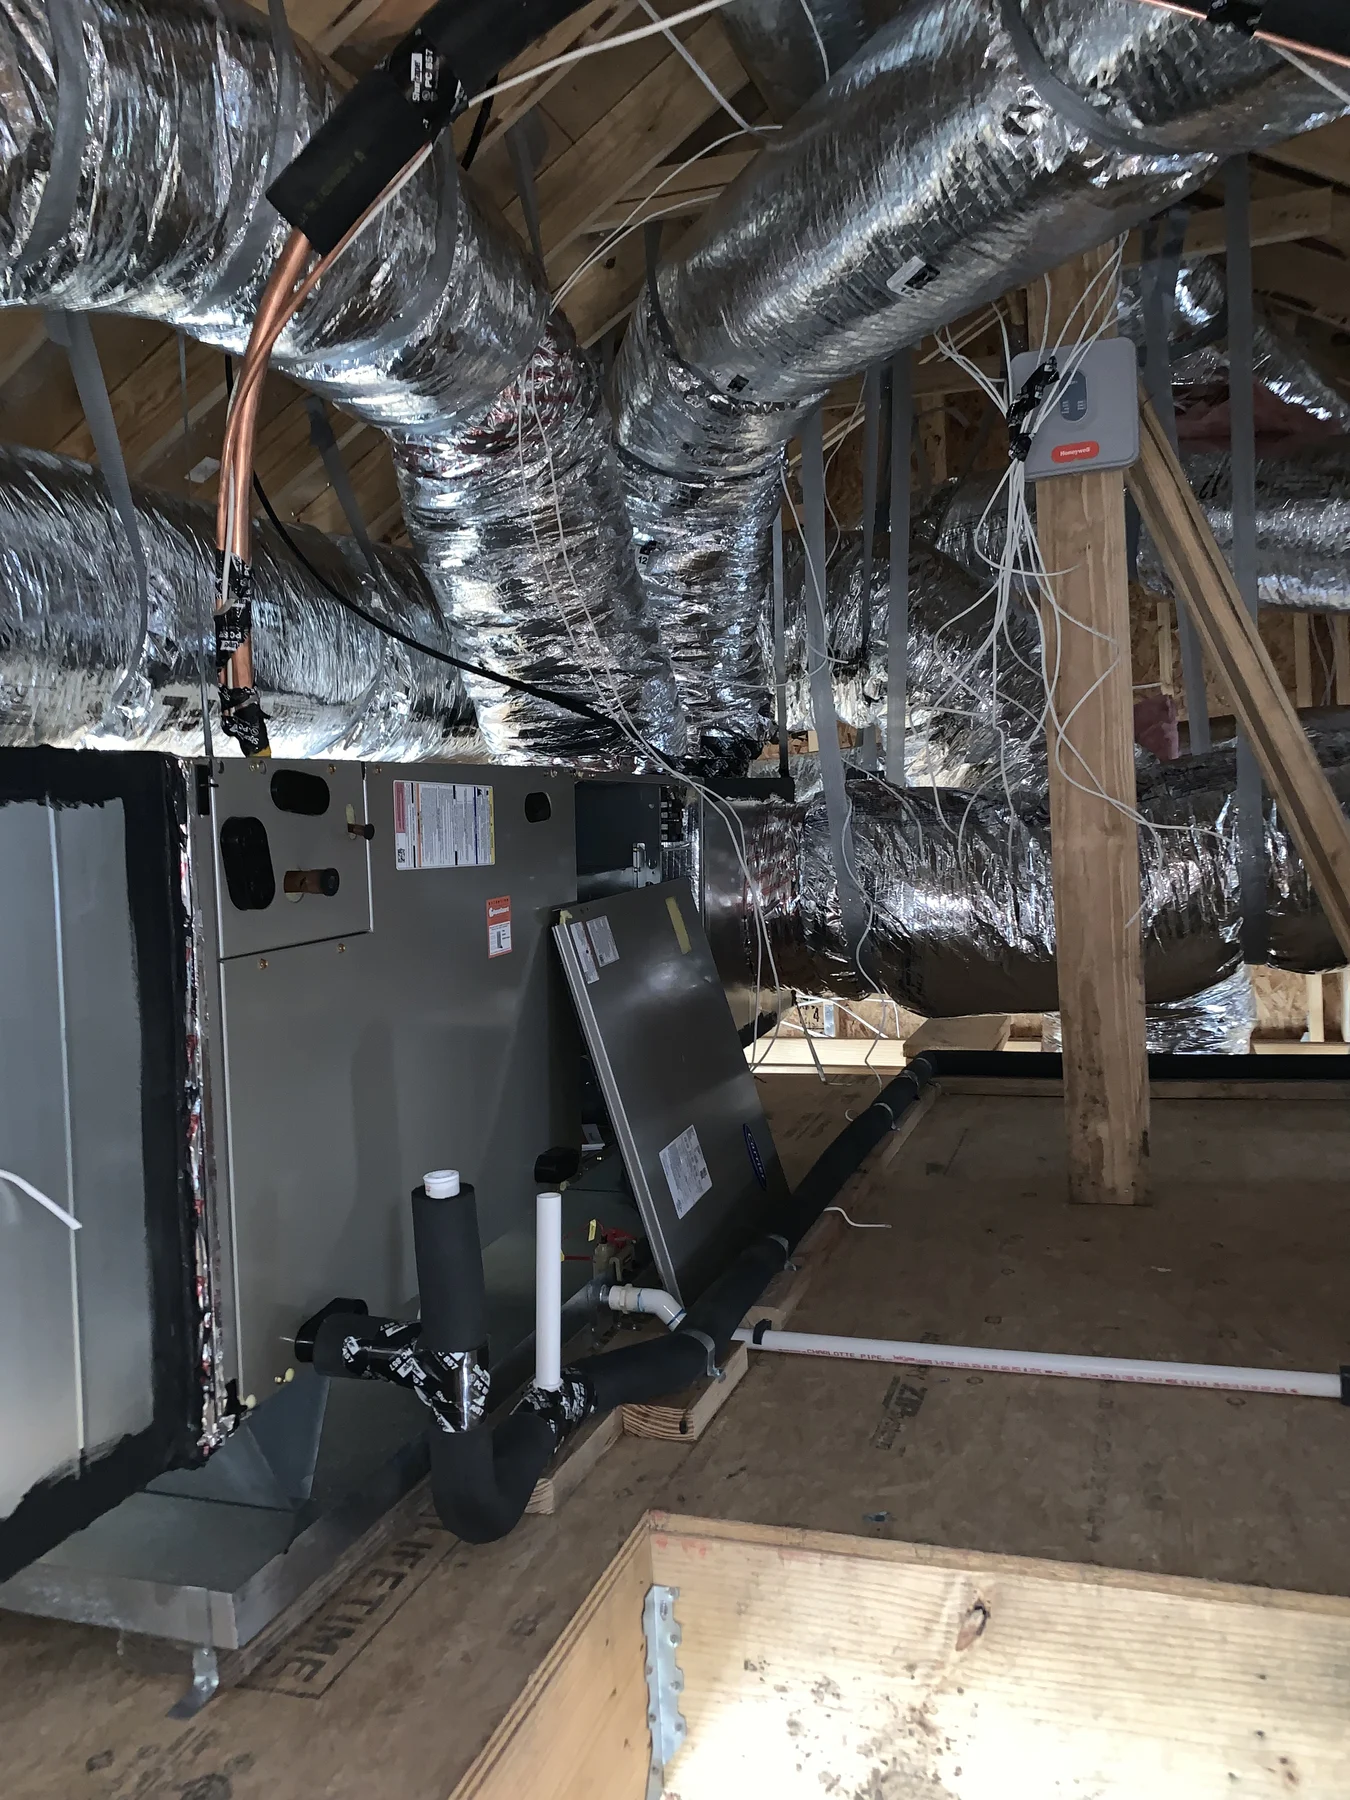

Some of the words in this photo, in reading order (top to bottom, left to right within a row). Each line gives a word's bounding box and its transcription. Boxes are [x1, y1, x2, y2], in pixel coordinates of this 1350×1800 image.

[424, 48, 434, 70] 857
[424, 72, 433, 88] PC
[1059, 446, 1091, 457] Honeywell
[637, 555, 648, 565] 12
[229, 631, 242, 641] PC
[806, 1348, 856, 1359] CHARLOTTE
[860, 1353, 882, 1361] PIPE
[443, 1355, 459, 1371] 857
[473, 1379, 484, 1391] PC
